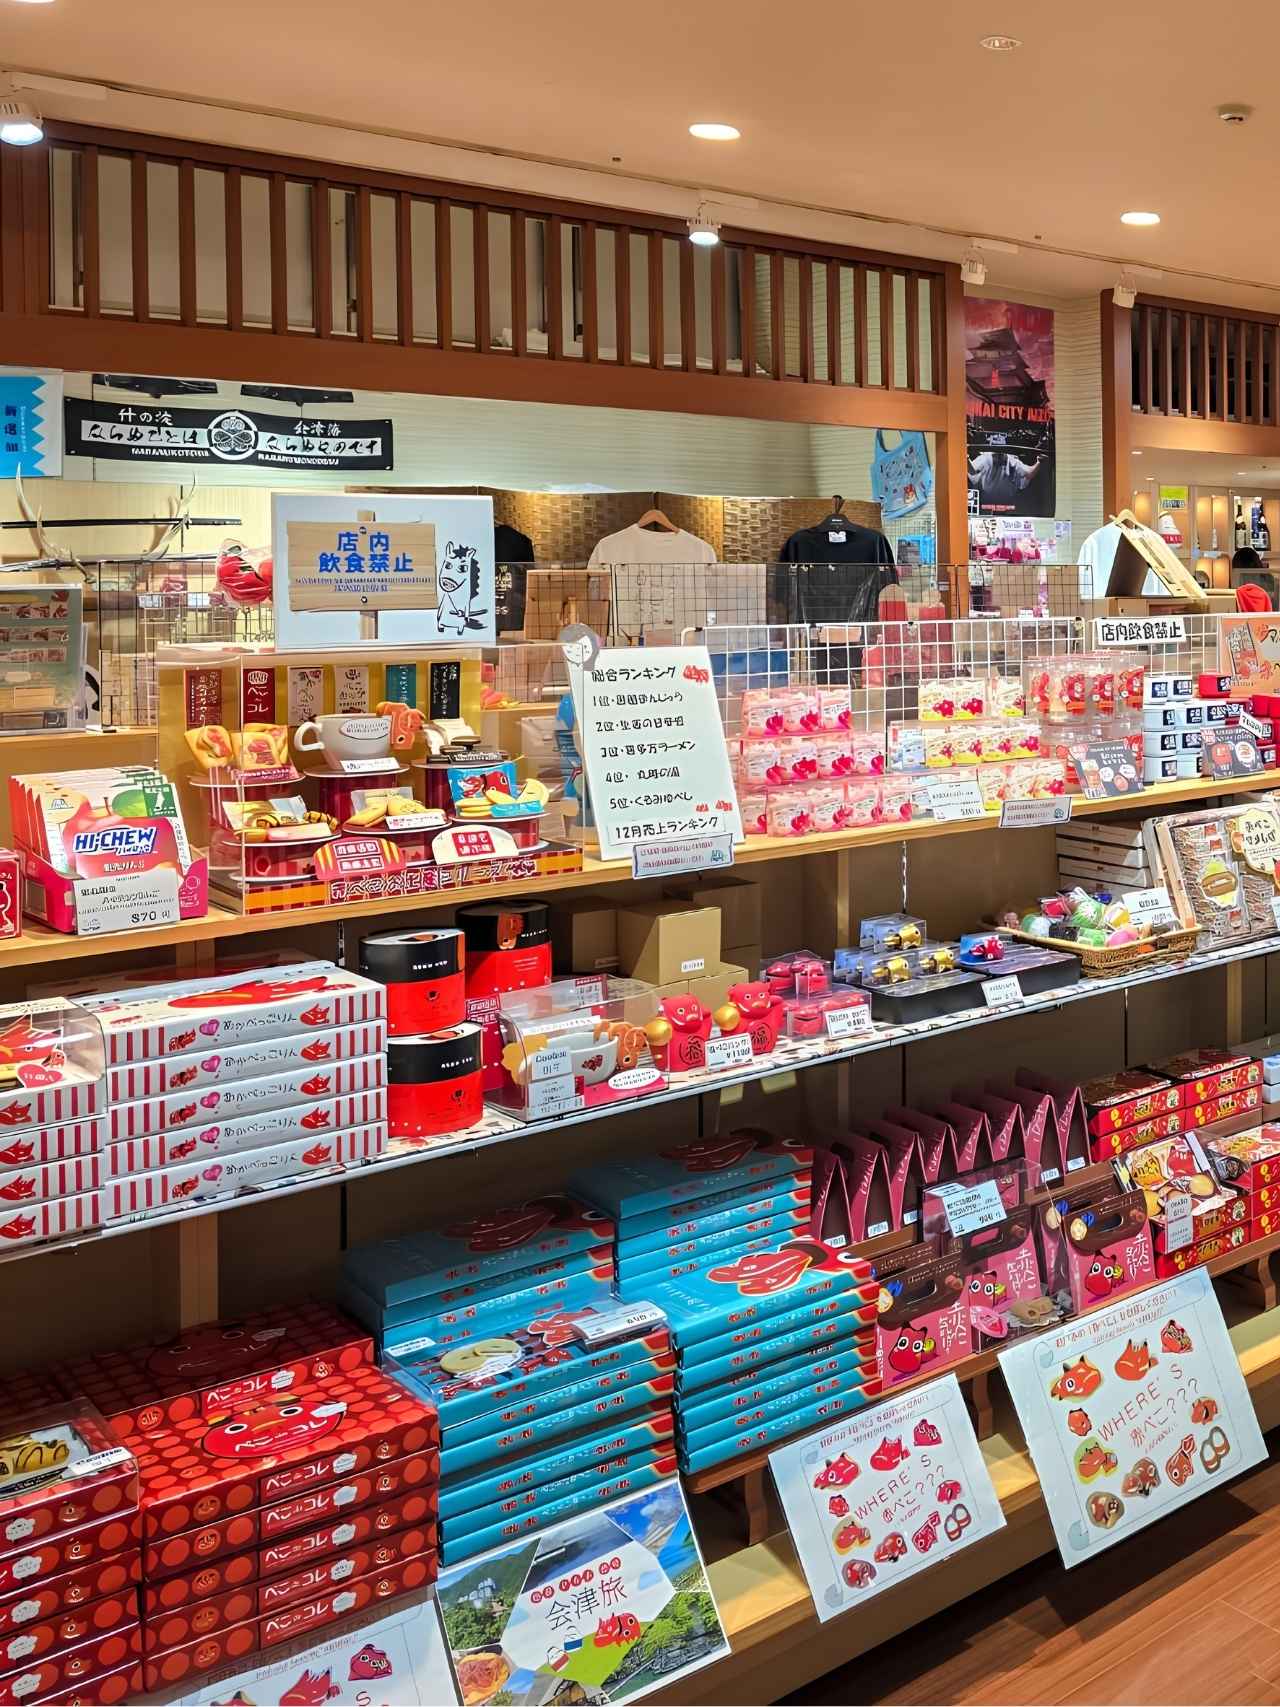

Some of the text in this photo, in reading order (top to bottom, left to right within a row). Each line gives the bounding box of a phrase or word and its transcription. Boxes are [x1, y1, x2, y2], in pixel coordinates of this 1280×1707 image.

[999, 404, 1025, 420] CITY
[337, 531, 390, 552] 店内
[318, 552, 414, 573] 飲食禁止
[545, 1576, 628, 1631] 会津旅
